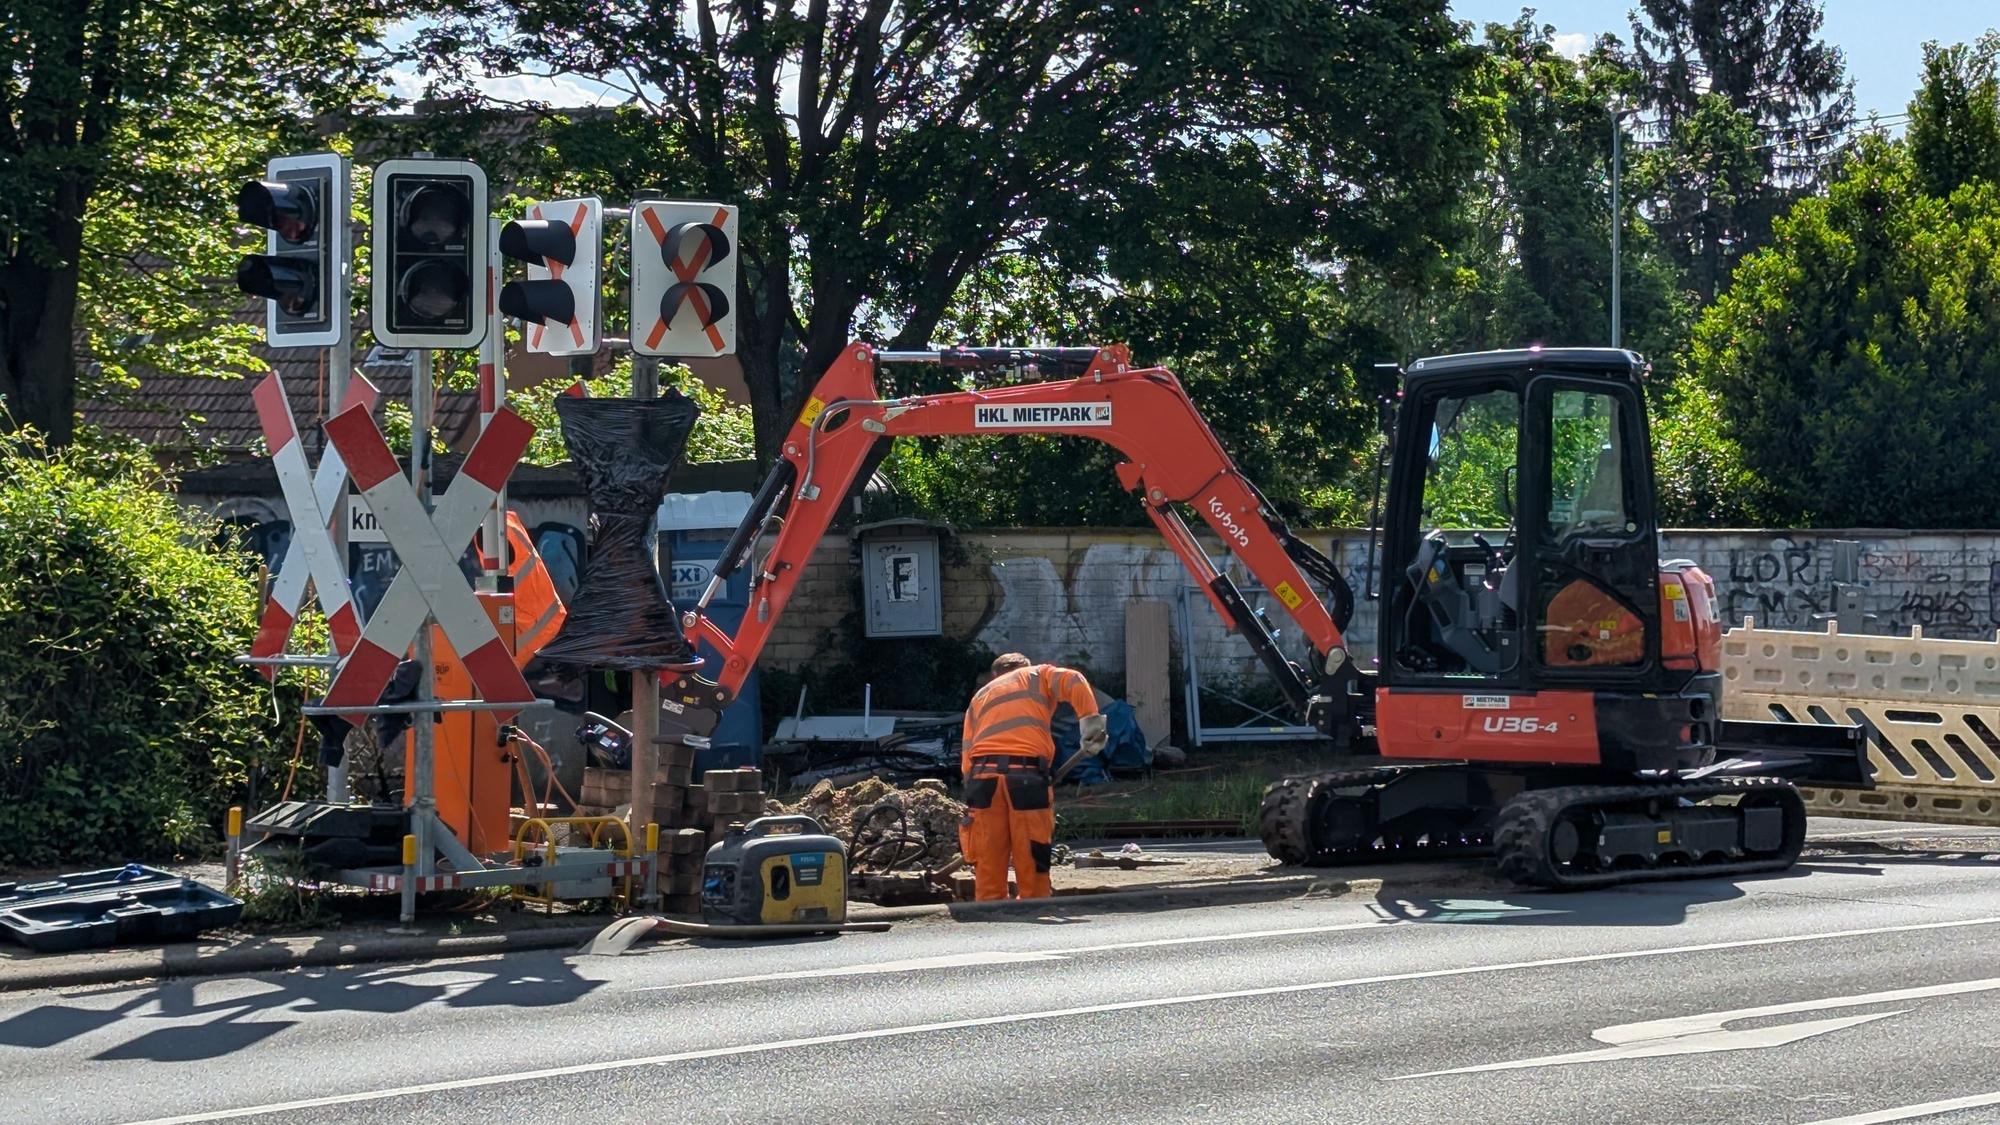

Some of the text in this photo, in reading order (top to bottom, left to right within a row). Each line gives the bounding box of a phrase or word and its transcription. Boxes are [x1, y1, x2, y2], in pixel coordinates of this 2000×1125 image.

[979, 406, 1092, 423] HKL MIETPARK
[1208, 496, 1249, 547] Kubota
[893, 557, 911, 599] F
[1483, 716, 1558, 733] U36-4
